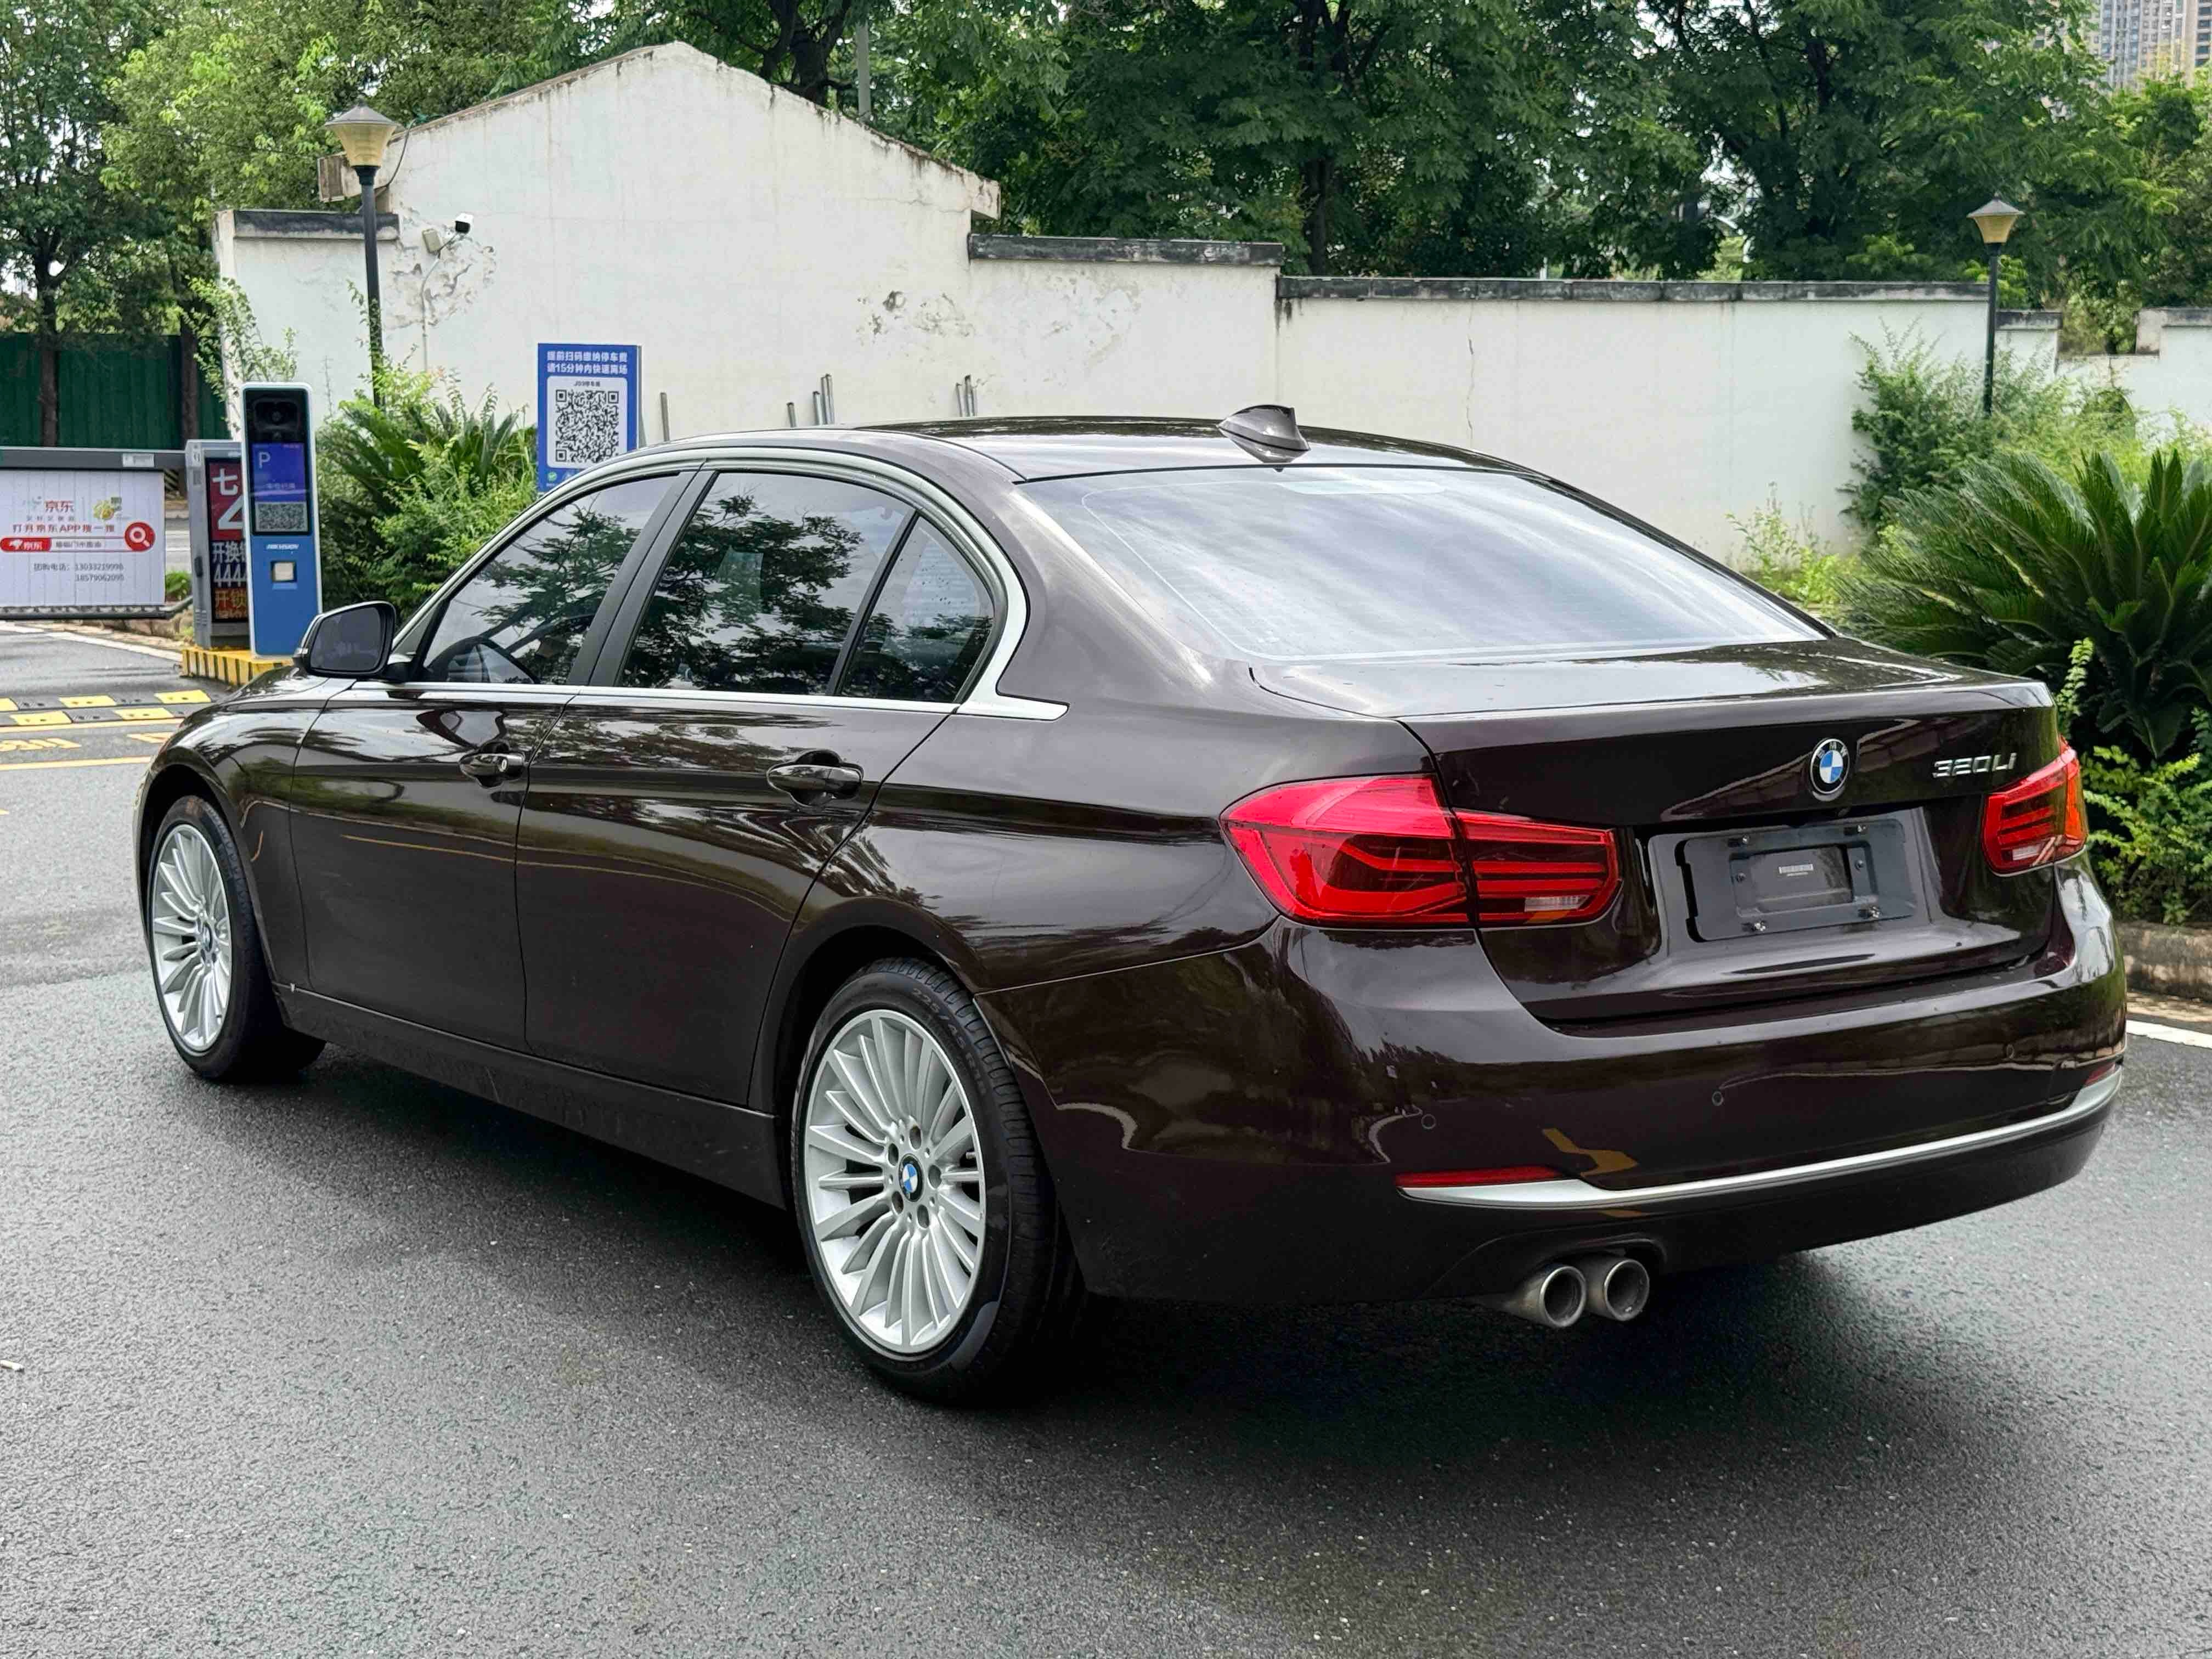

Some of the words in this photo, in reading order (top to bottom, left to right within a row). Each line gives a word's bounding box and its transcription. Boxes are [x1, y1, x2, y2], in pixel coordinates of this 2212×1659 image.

[258, 452, 270, 468] P
[45, 500, 75, 513] 京东
[213, 564, 247, 588] 444
[1816, 741, 1848, 759] BMW
[1932, 752, 2018, 779] 320Li
